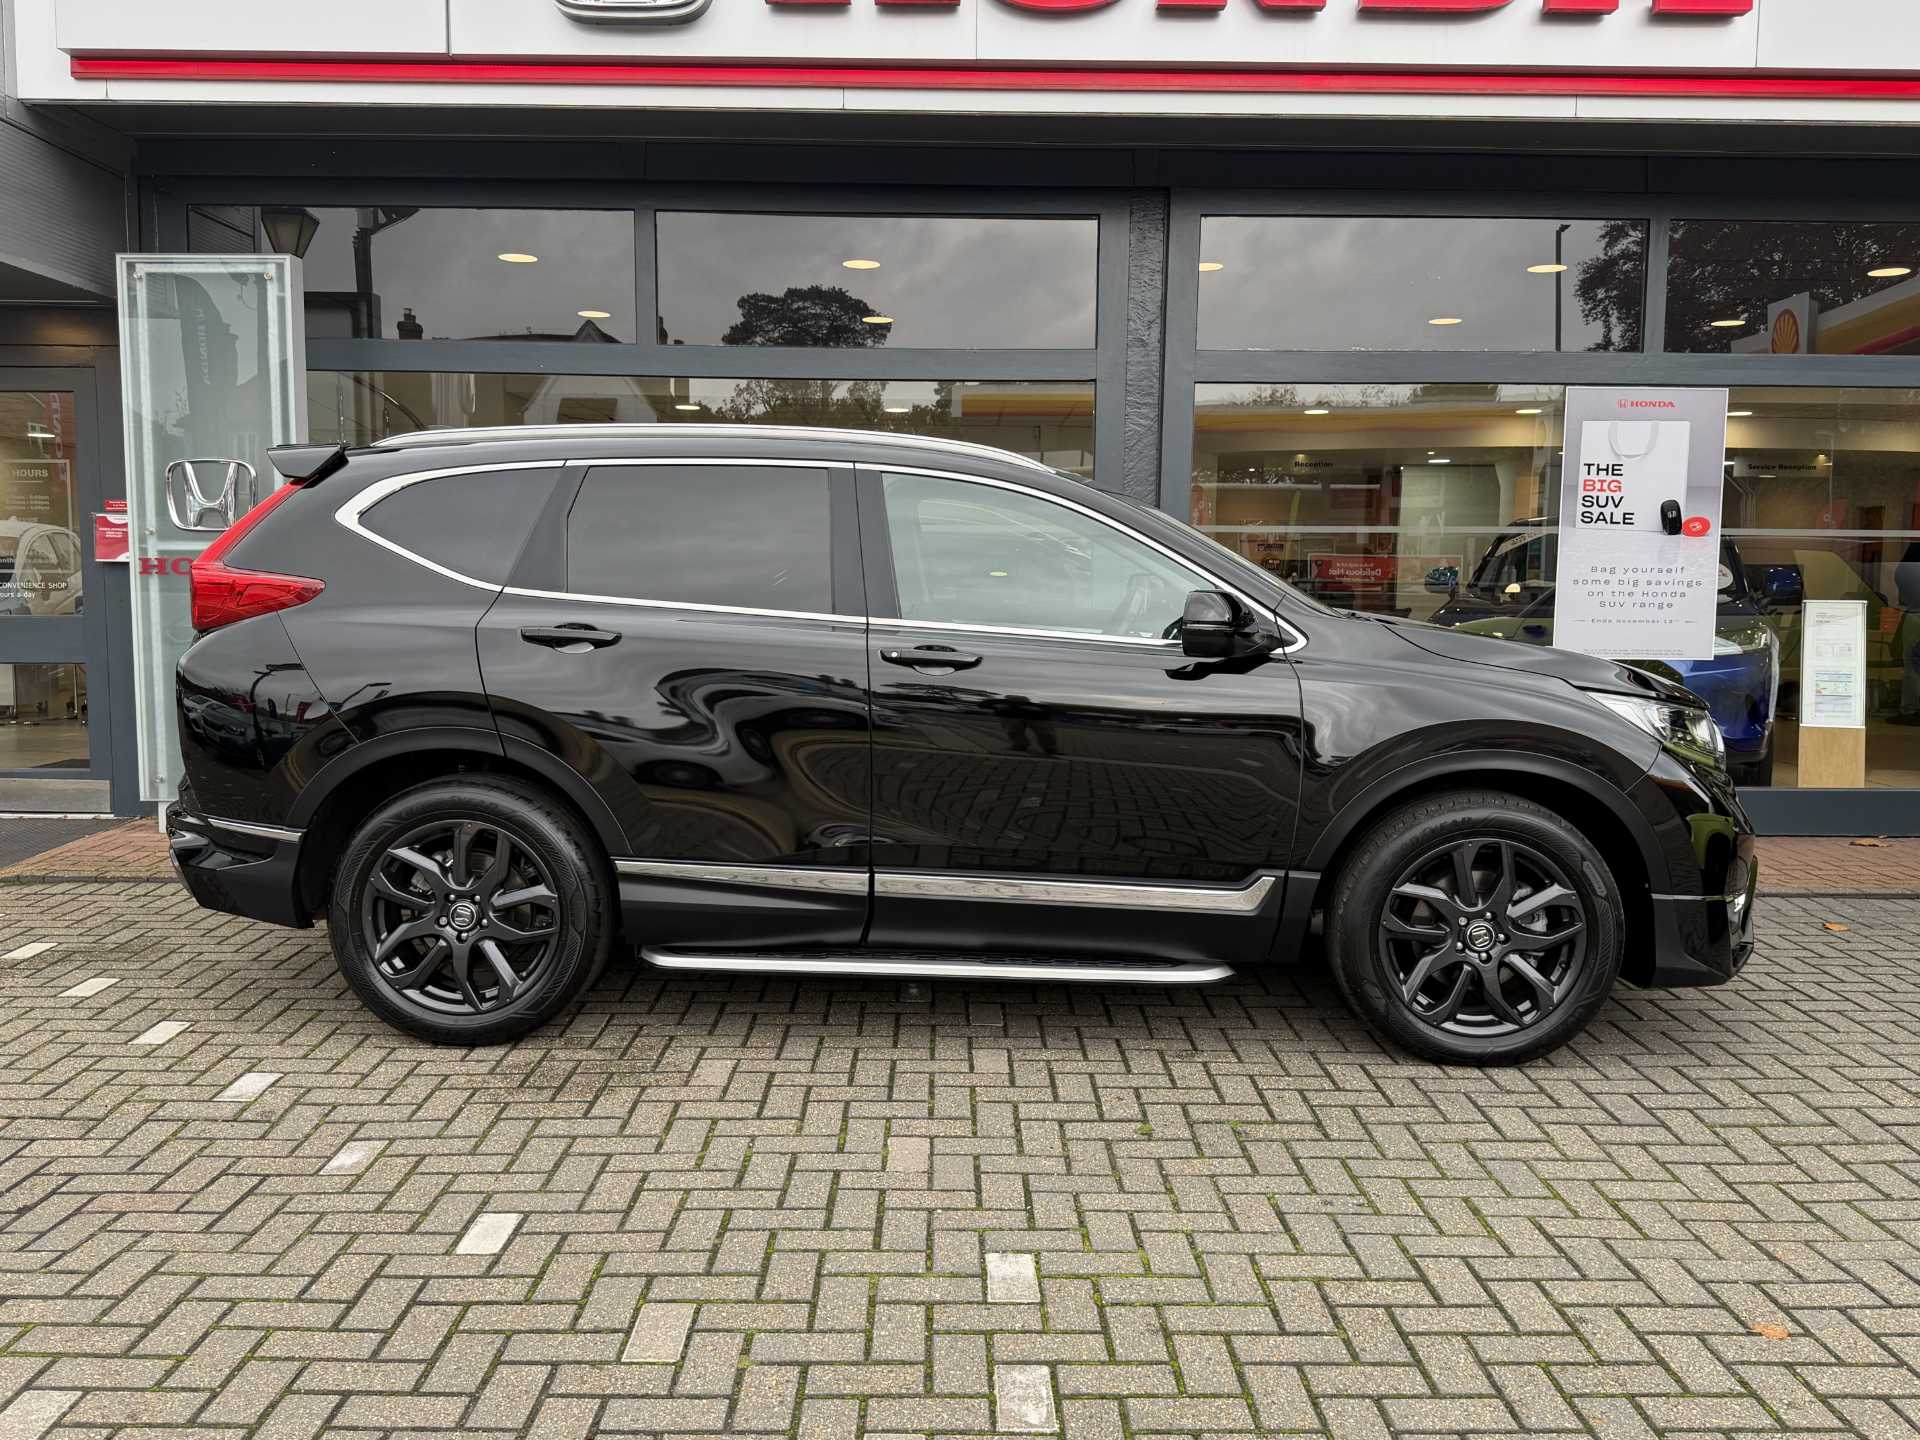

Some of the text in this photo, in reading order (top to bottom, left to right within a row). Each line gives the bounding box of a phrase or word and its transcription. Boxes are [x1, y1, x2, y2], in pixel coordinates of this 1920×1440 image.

[1630, 400, 1676, 408] HONDA
[1294, 461, 1334, 469] Reception
[1583, 463, 1624, 476] THE
[1583, 479, 1622, 493] BIG
[1581, 495, 1624, 508] SUV
[1580, 511, 1635, 525] SALE
[138, 555, 193, 576] HO
[1590, 565, 1686, 575] Bag yourself
[48, 581, 68, 589] SHOP
[1572, 578, 1703, 588] some big savings
[23, 591, 36, 599] day
[1611, 590, 1635, 598] the
[1641, 590, 1687, 598] Honda
[1599, 600, 1674, 610] SUV range
